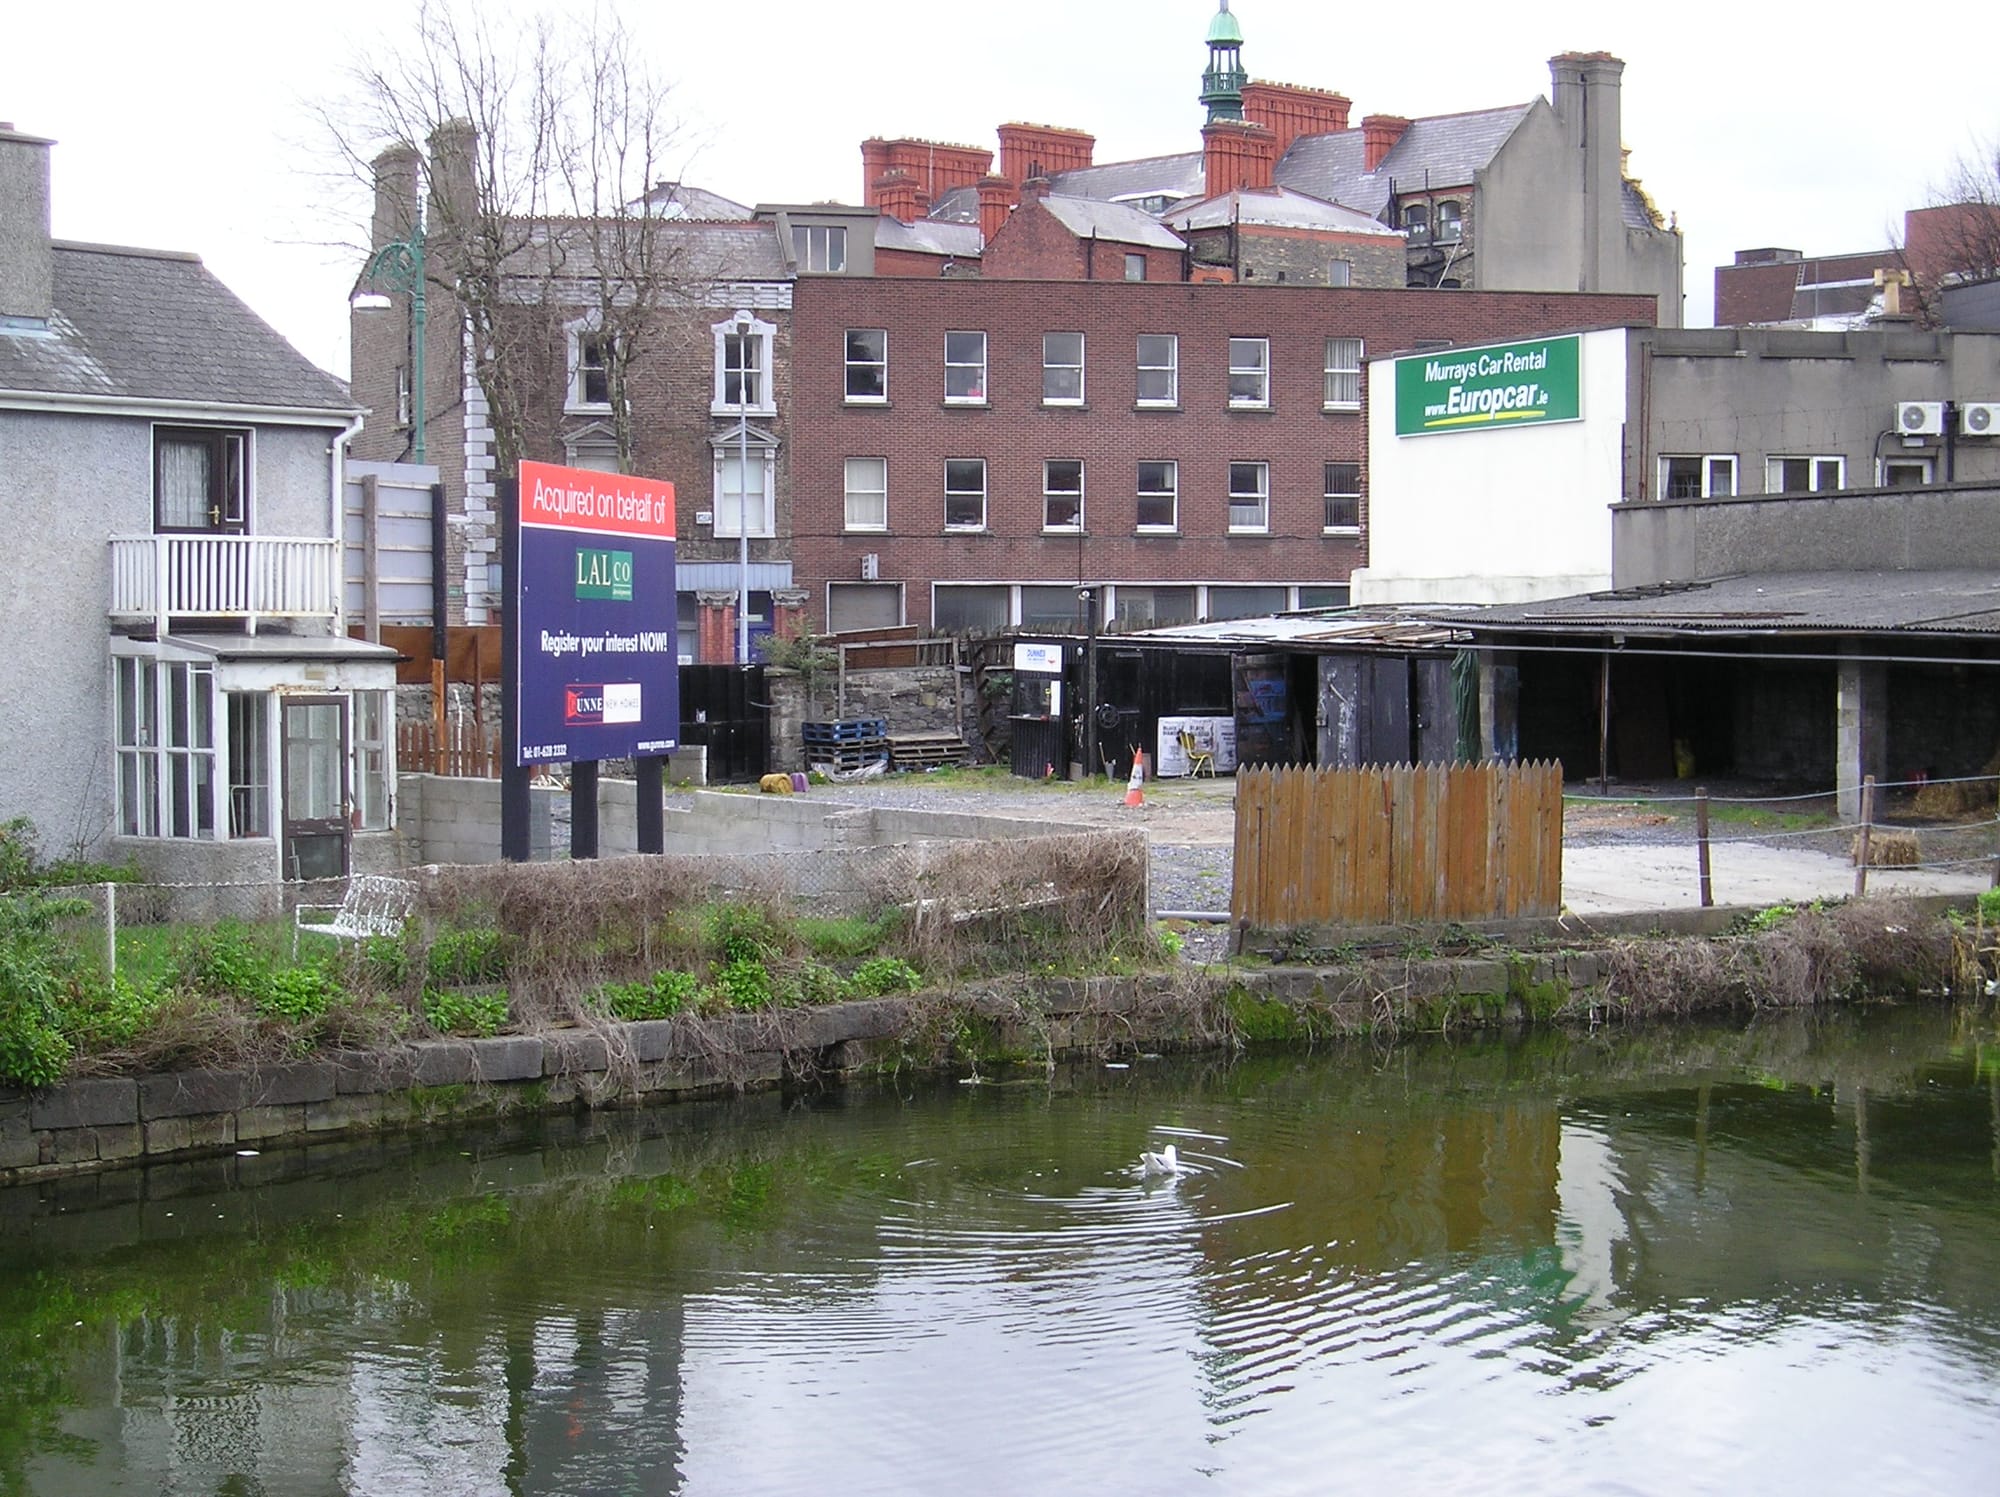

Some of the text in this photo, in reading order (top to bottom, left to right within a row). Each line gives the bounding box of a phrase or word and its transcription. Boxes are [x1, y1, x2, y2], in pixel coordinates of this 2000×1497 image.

[1425, 348, 1547, 384] Murrays Car Rental
[533, 478, 666, 524] Acquired on behalf of
[541, 630, 668, 659] Register your interest NOW!
